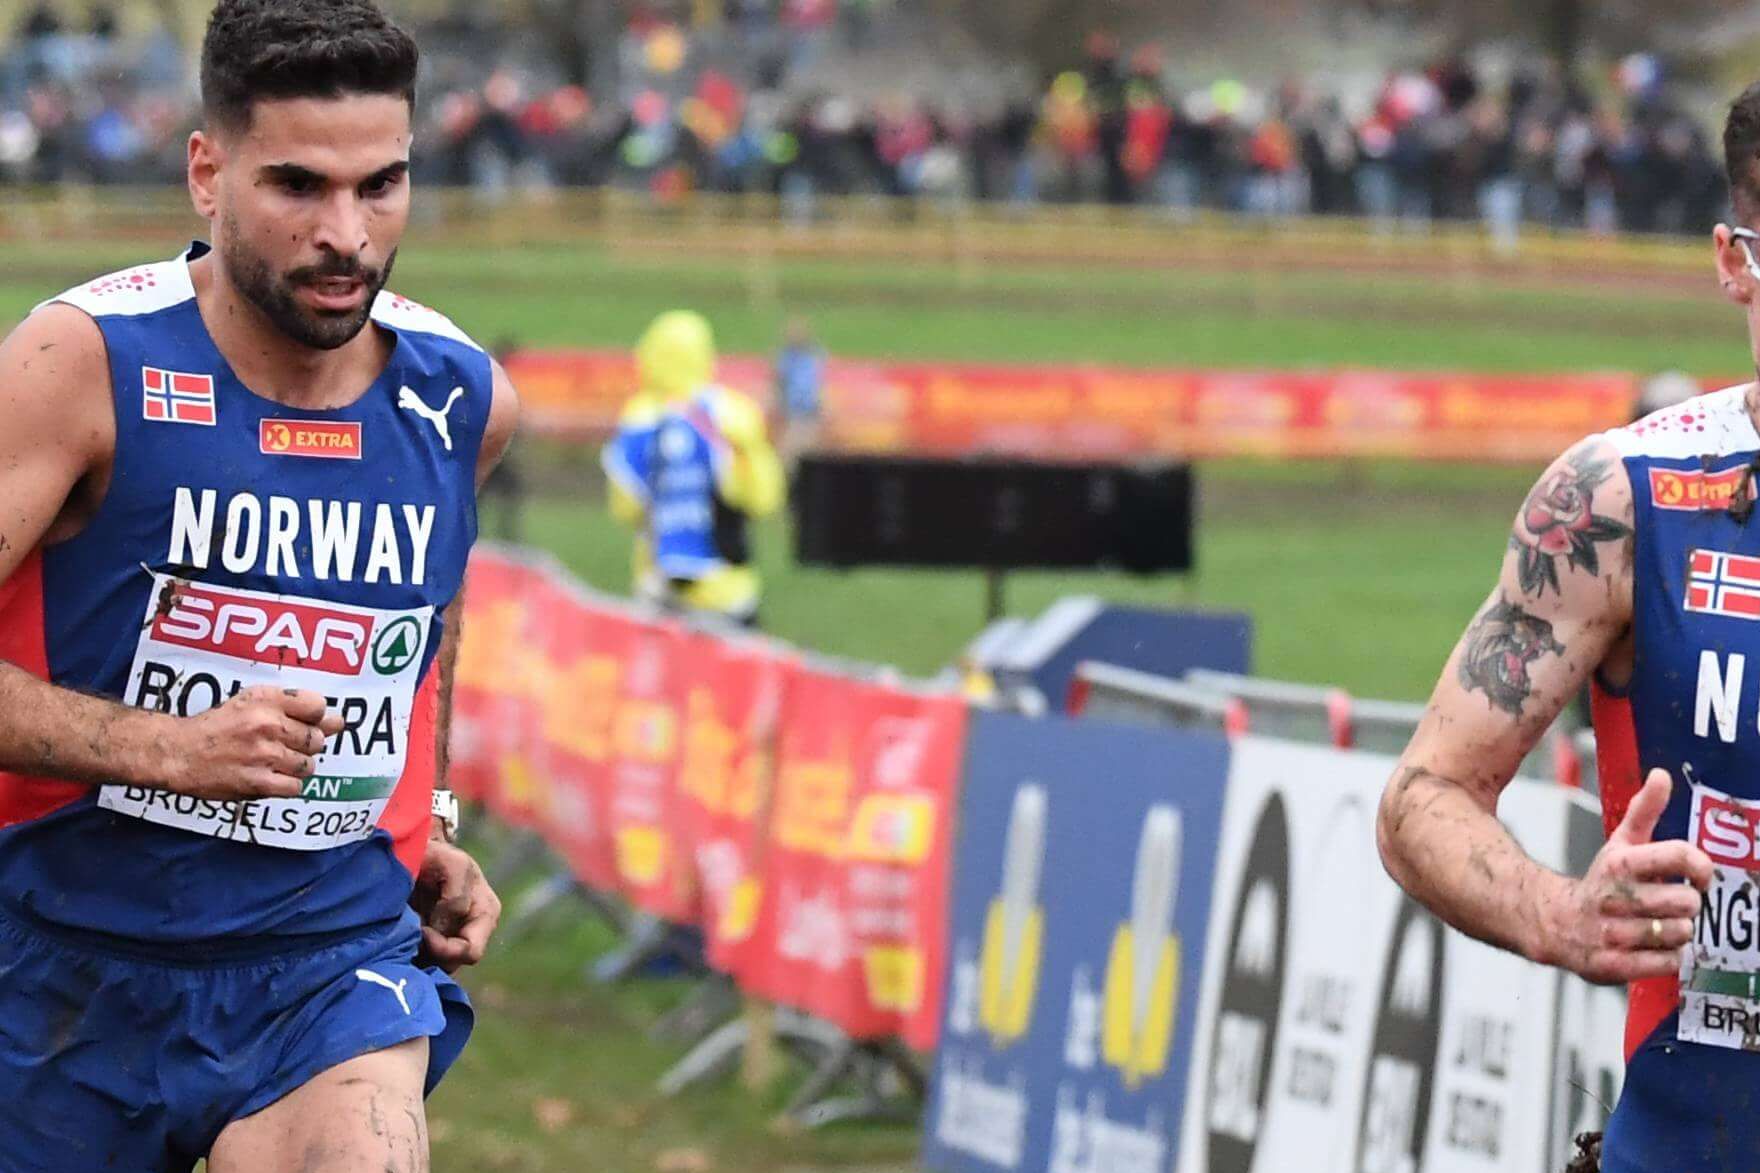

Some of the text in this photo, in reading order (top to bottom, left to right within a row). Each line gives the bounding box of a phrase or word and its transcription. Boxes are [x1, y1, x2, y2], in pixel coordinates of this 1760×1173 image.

[296, 431, 353, 448] EXTRA
[168, 487, 436, 585] NORWAY
[159, 595, 368, 667] SPAR
[305, 810, 370, 836] 2023
